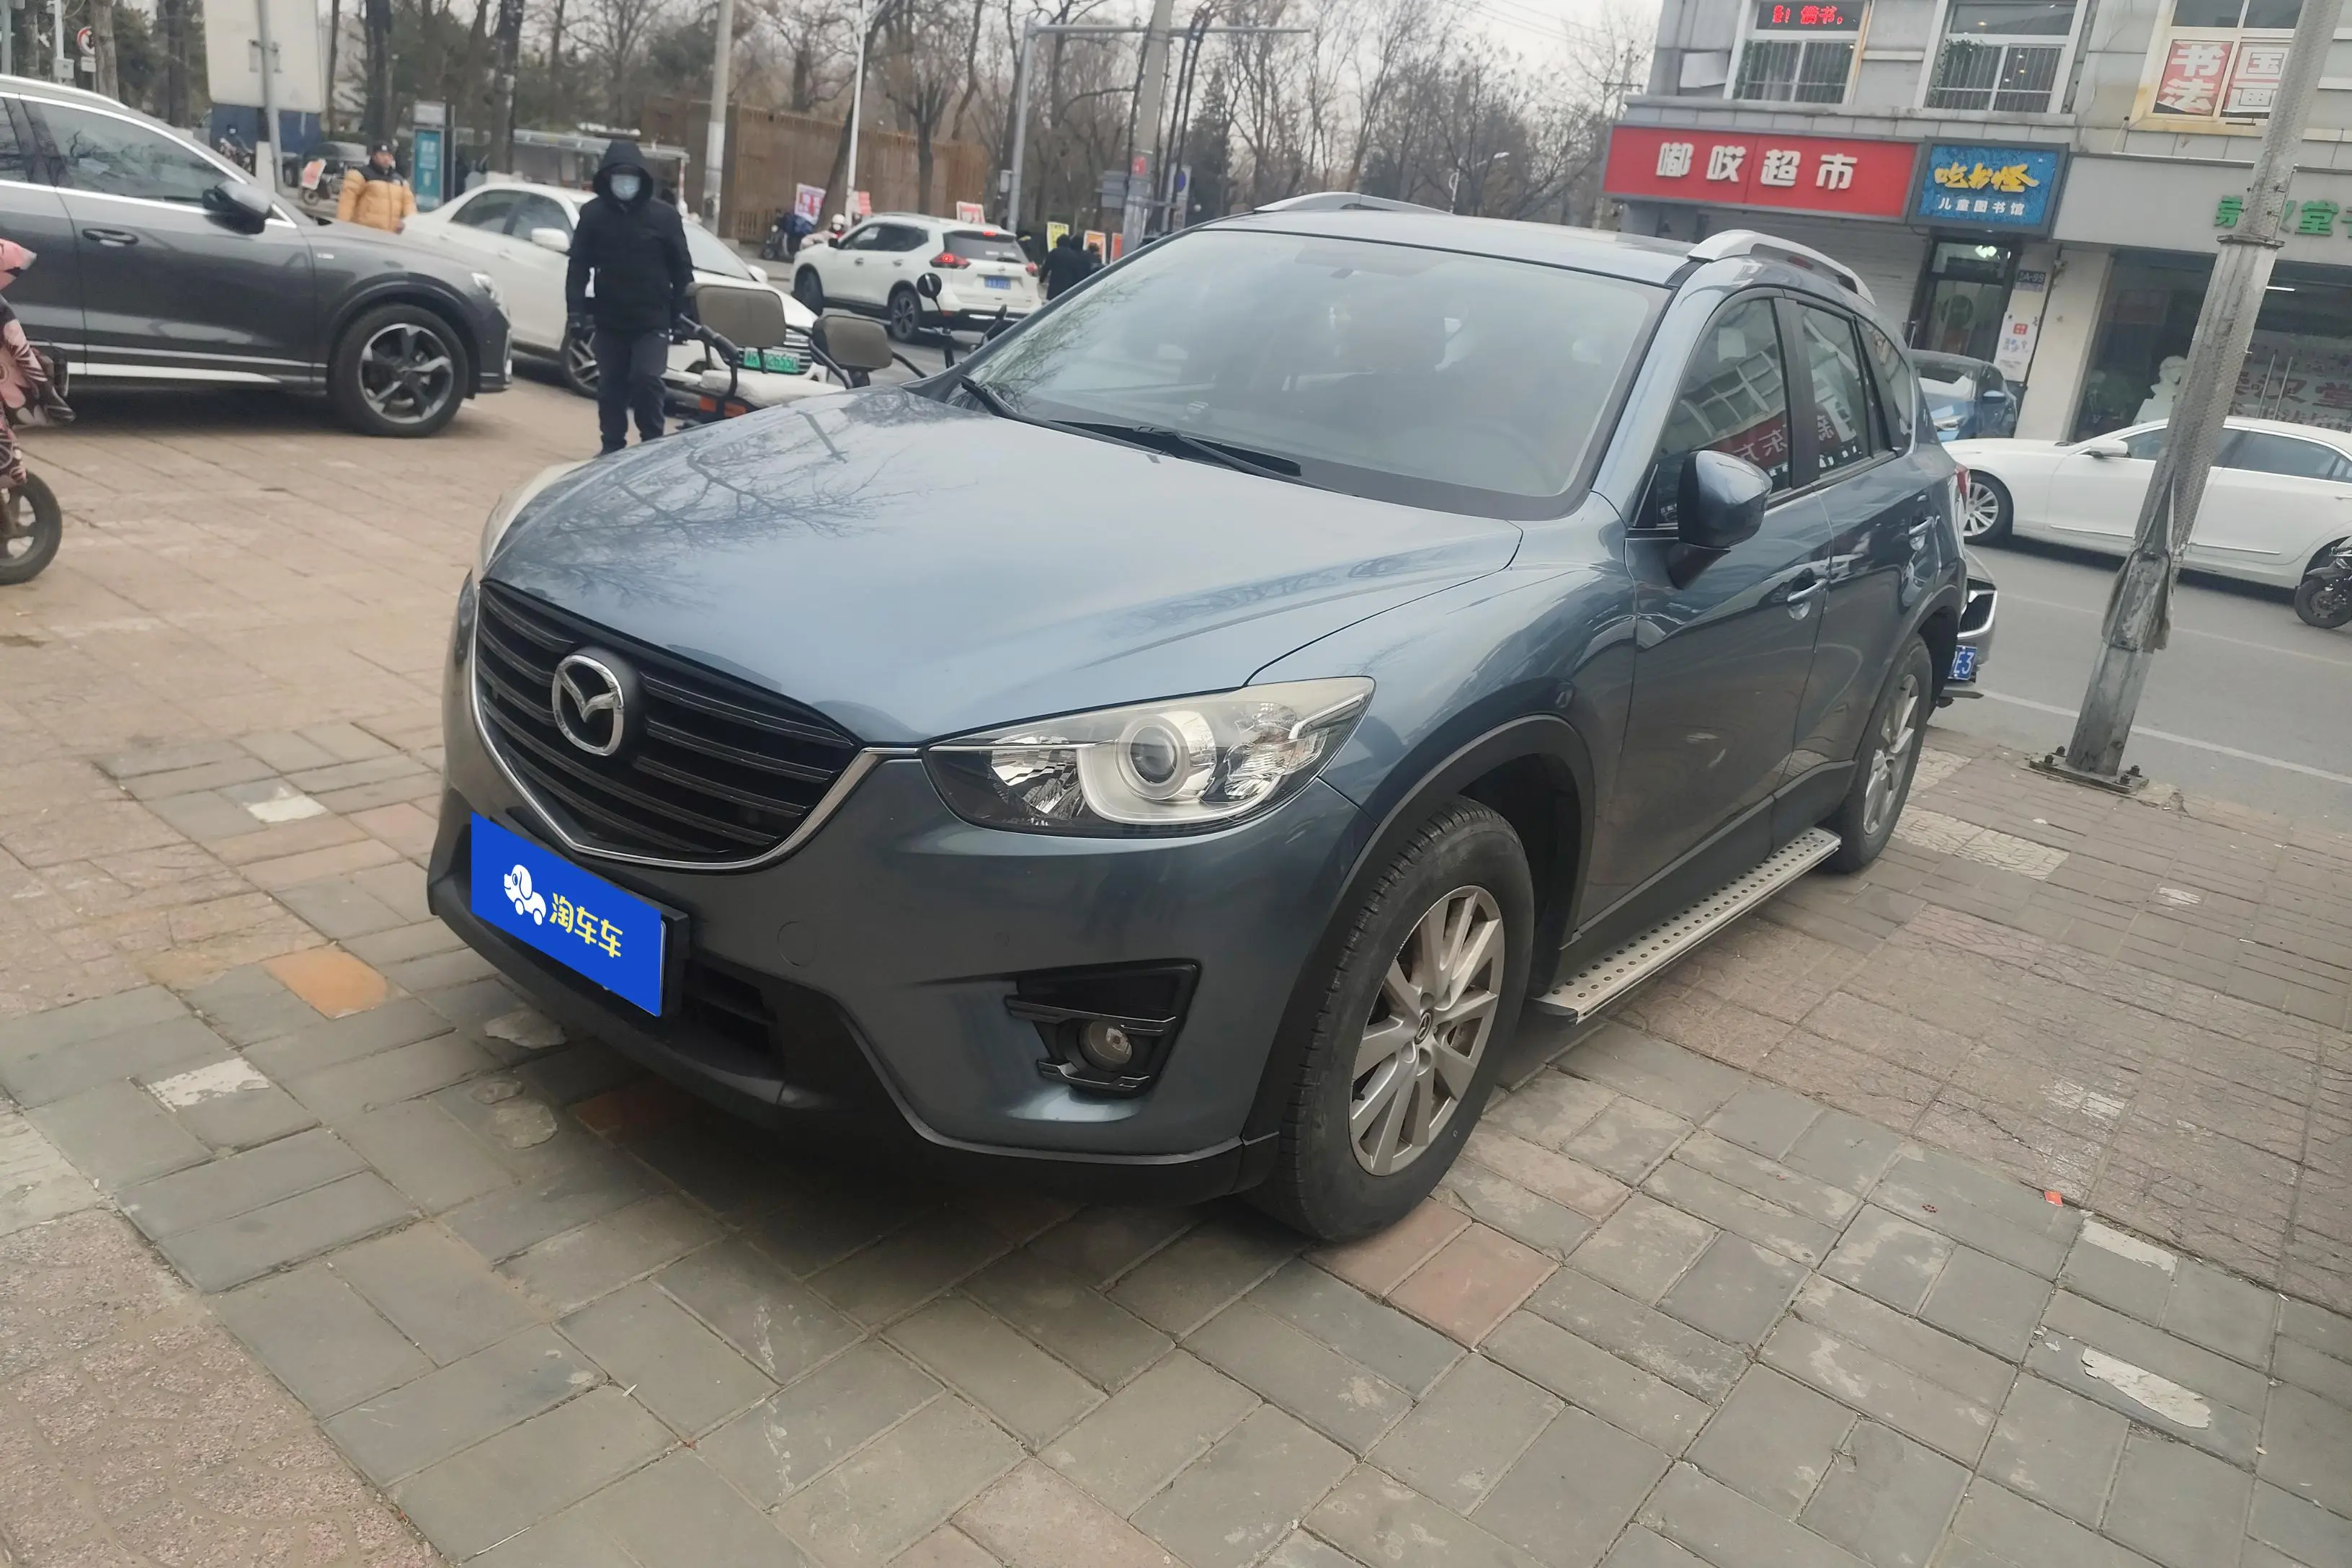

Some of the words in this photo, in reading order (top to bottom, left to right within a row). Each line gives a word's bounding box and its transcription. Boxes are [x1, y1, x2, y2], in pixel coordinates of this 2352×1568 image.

[2163, 44, 2226, 111] 书法
[1938, 197, 2025, 216] 儿童图书馆
[1952, 651, 1974, 674] E3
